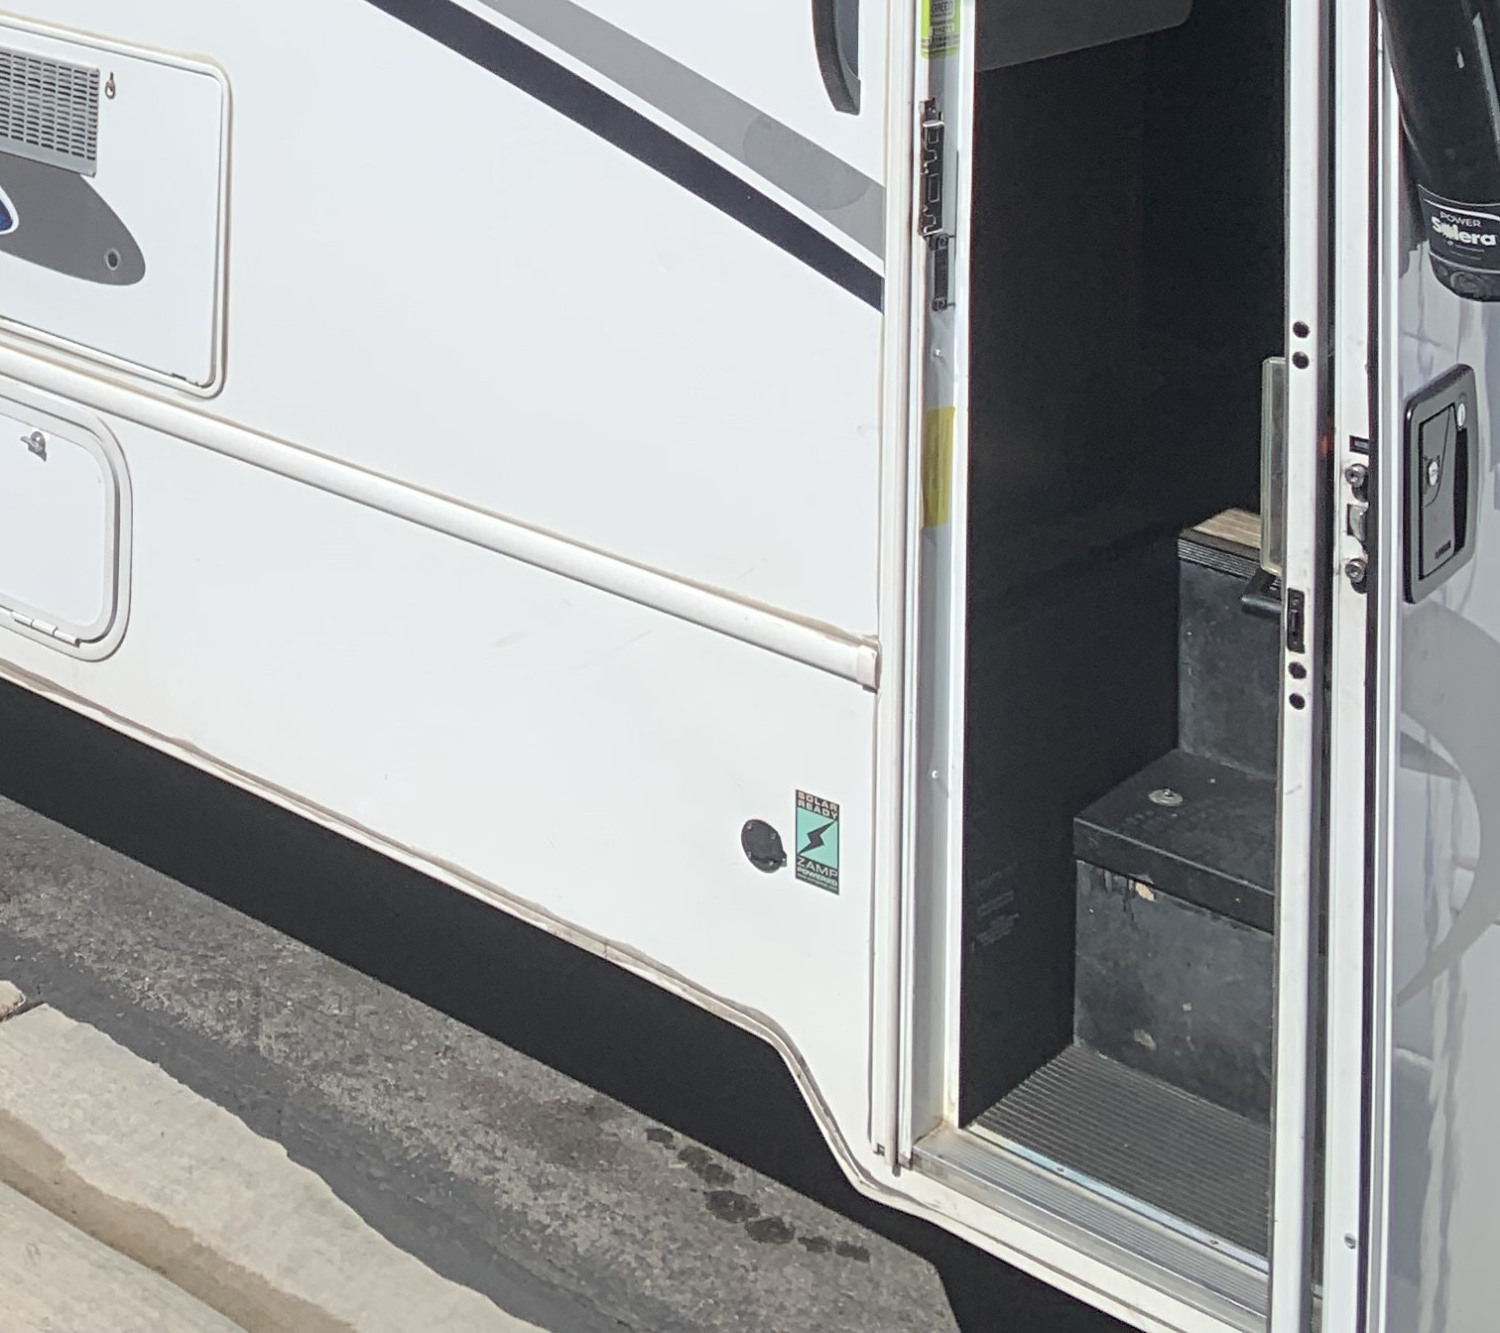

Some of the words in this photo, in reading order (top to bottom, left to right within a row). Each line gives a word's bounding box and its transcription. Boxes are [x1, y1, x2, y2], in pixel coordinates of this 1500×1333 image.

[1440, 211, 1481, 227] POWER
[797, 791, 838, 812] SOLAR
[797, 800, 838, 820] READY
[797, 856, 838, 878] ZAMP
